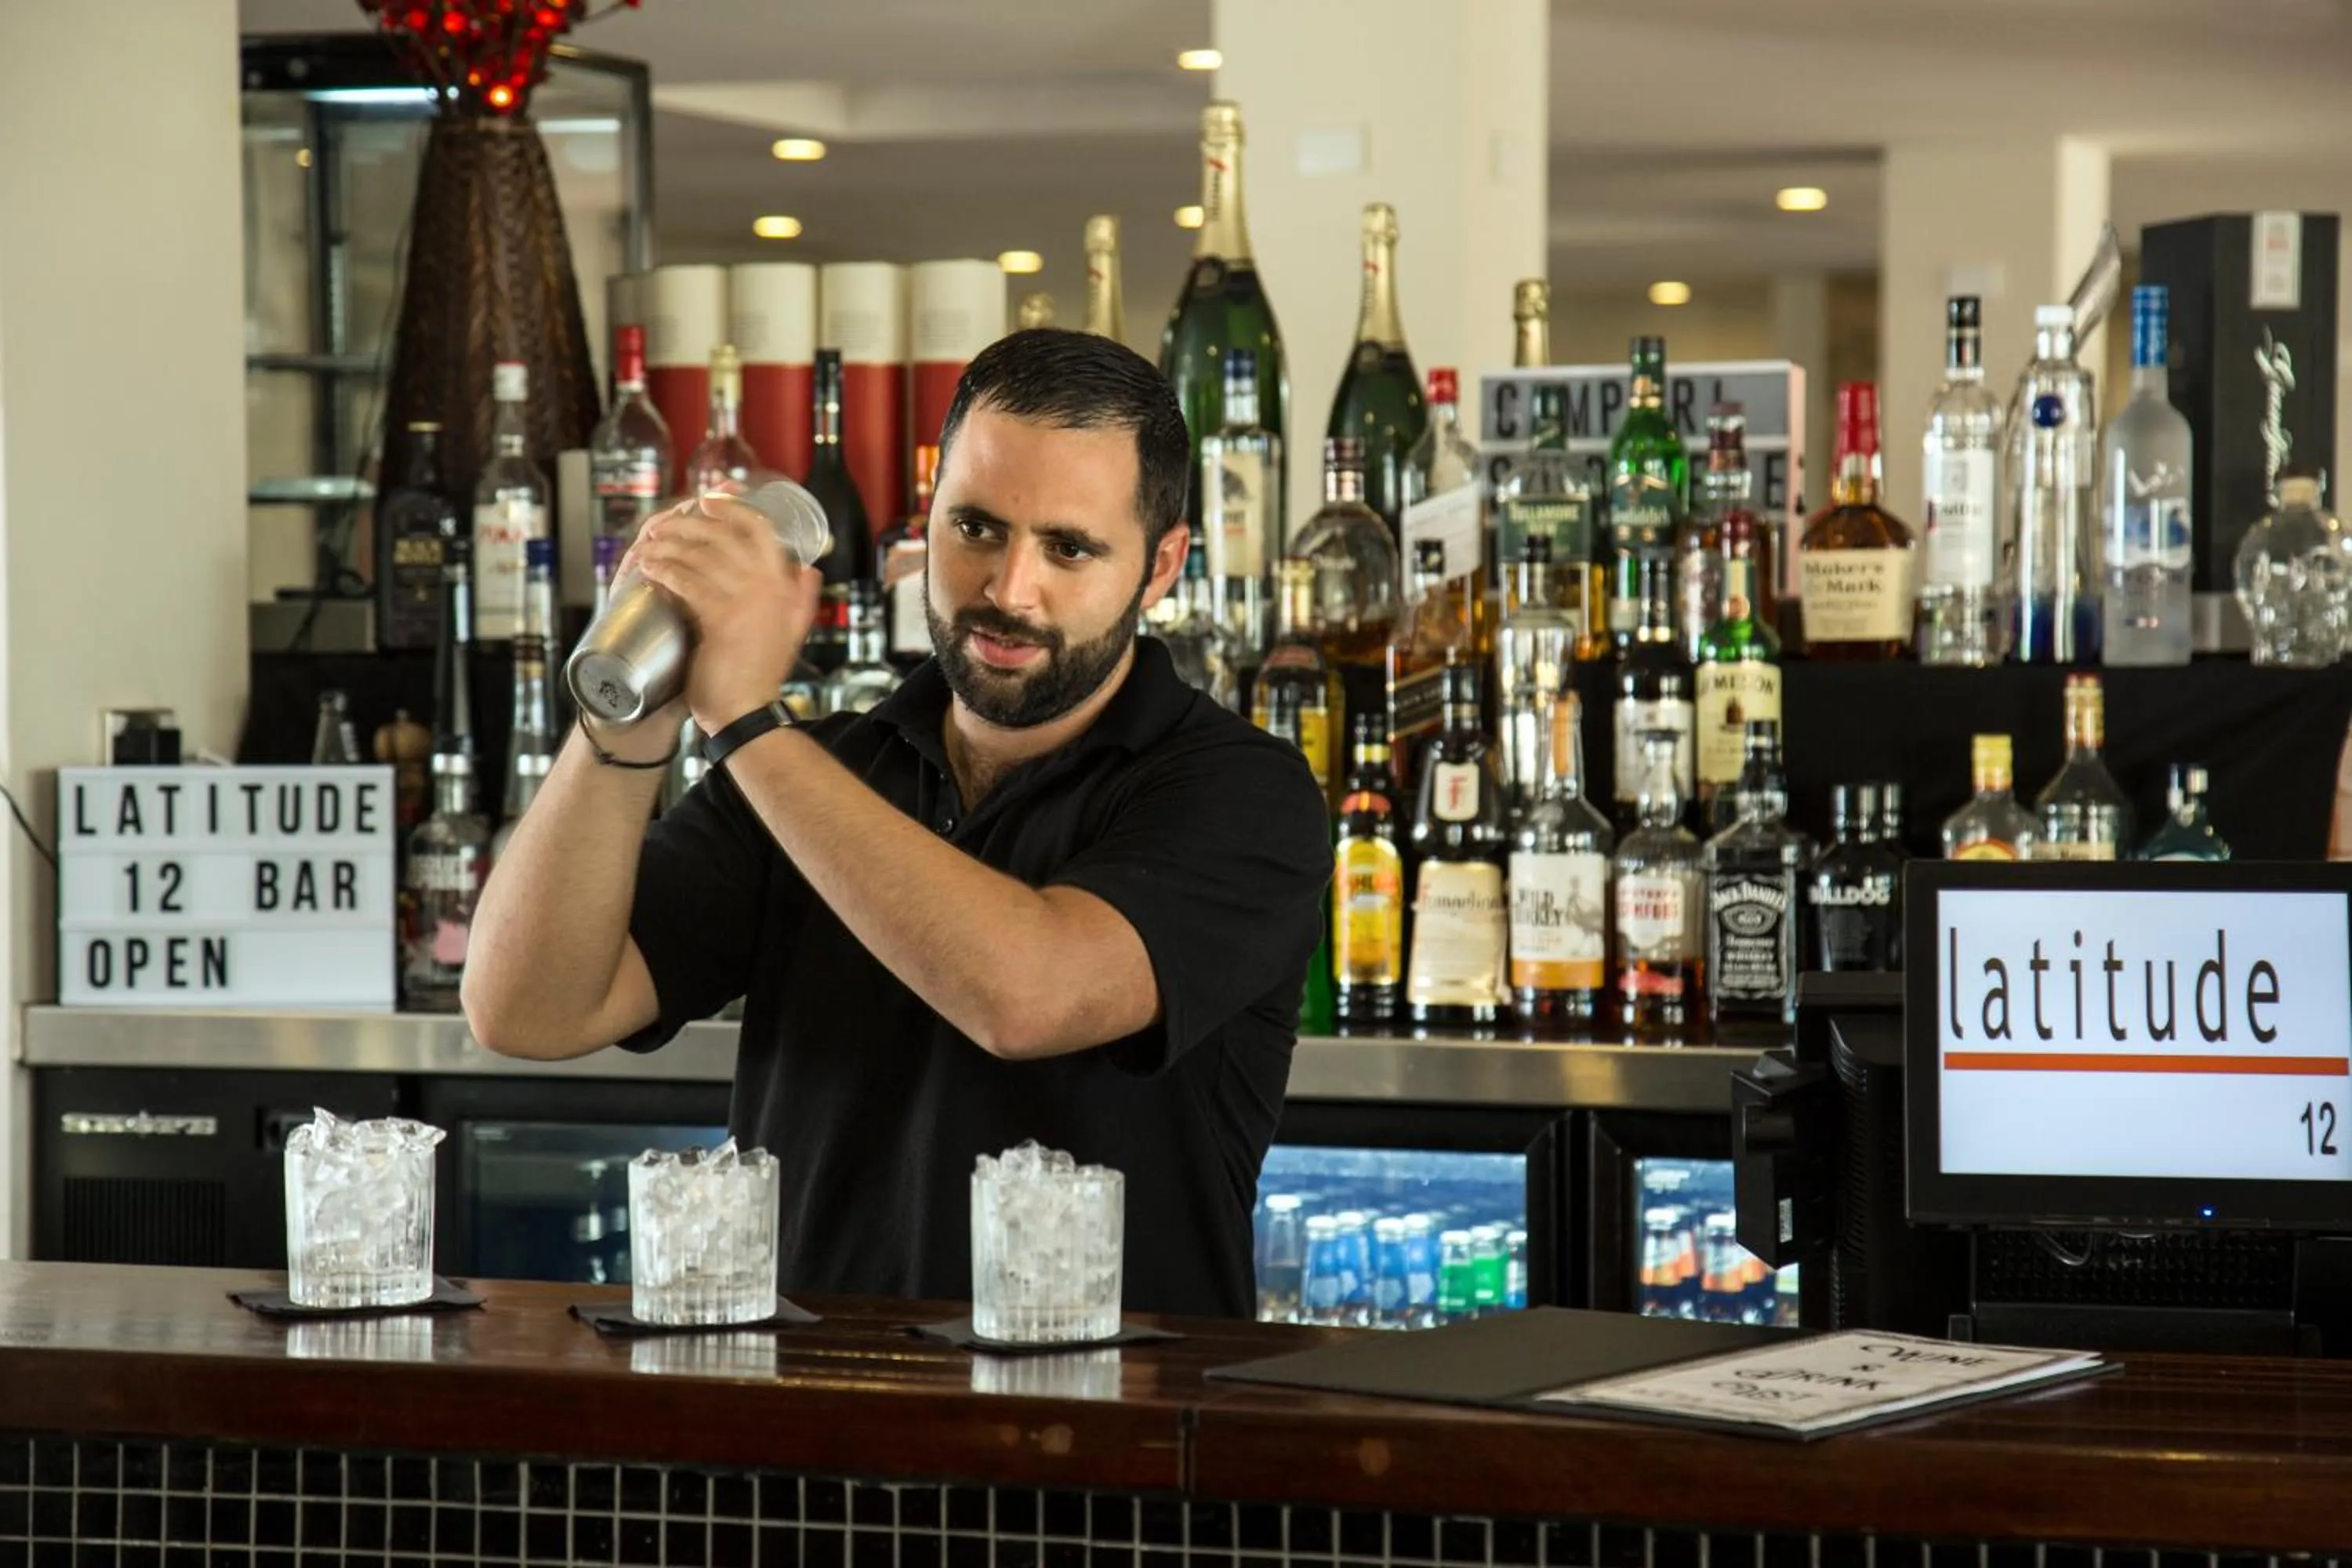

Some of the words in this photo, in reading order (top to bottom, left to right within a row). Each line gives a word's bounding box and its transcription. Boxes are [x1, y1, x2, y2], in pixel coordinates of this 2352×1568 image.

[1496, 377, 1723, 438] CMPR
[74, 783, 377, 836] LATITUDE
[123, 862, 184, 913] 12
[255, 861, 358, 911] BAR
[86, 937, 227, 989] OPEN
[1949, 927, 2280, 1044] latitude
[2299, 1101, 2339, 1156] 12
